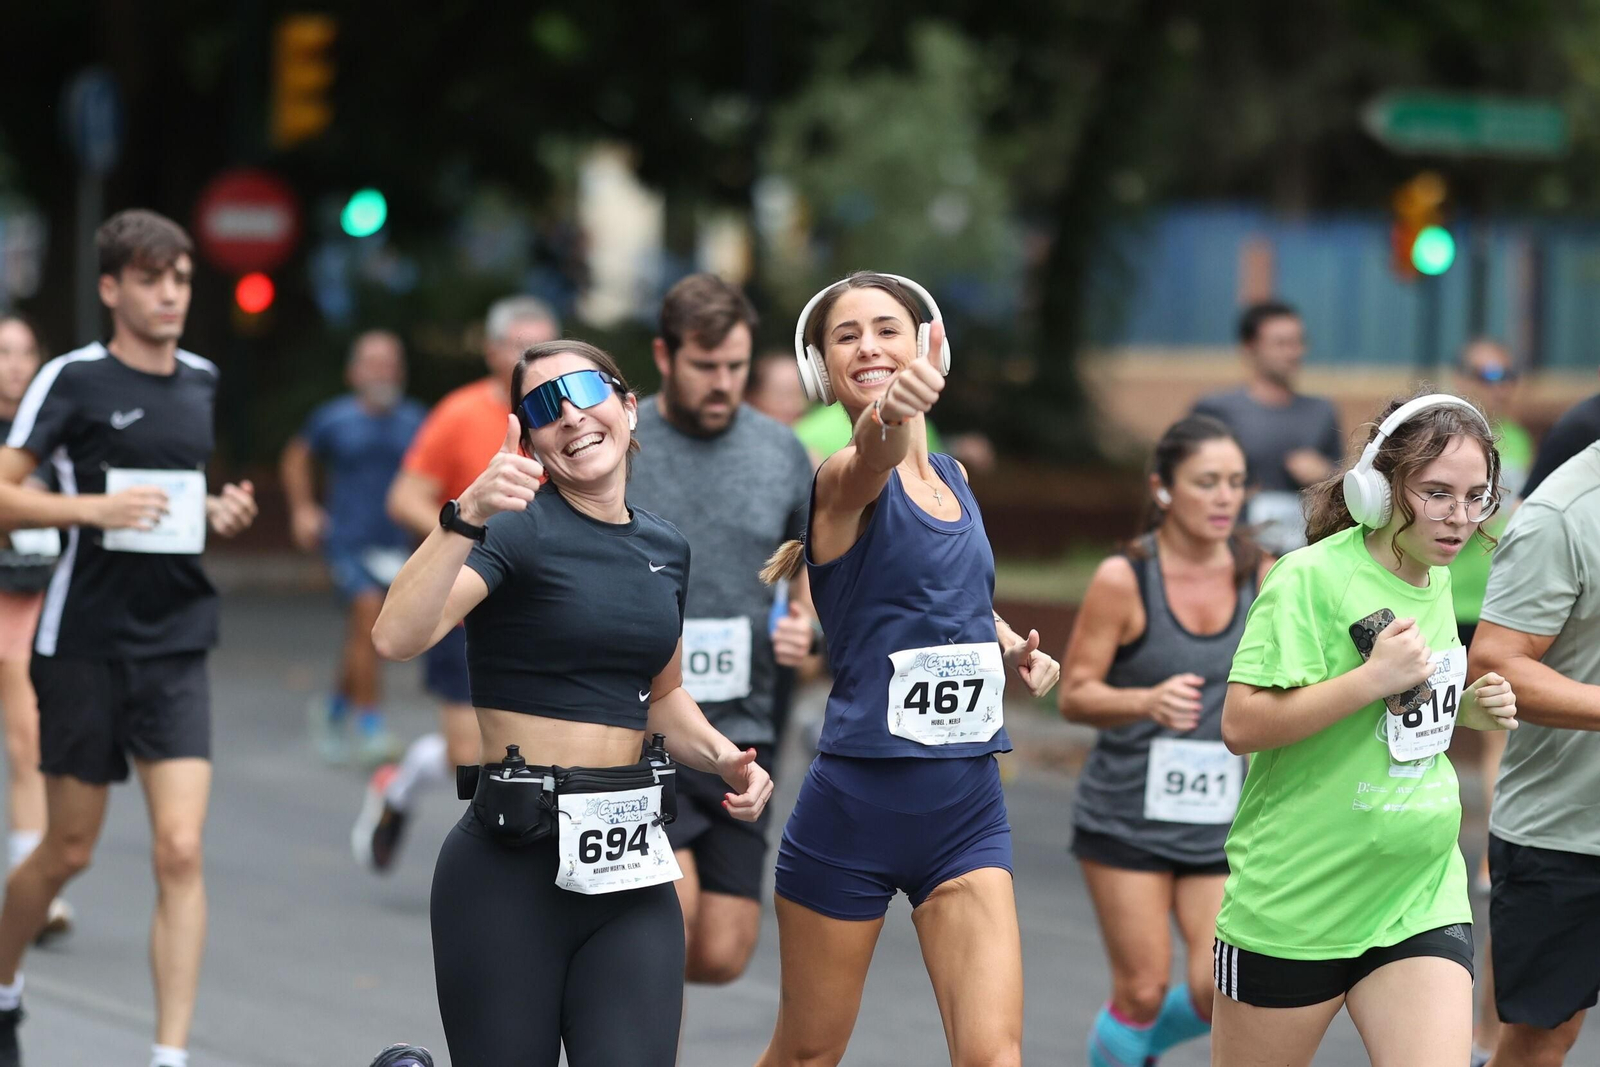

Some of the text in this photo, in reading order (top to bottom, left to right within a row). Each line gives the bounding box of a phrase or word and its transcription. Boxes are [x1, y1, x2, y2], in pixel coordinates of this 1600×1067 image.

[689, 650, 734, 675] 06
[926, 653, 972, 669] Carrera
[936, 664, 976, 677] Prensa
[904, 679, 984, 714] 467
[1165, 770, 1226, 797] 941
[599, 799, 641, 816] Carrera
[608, 811, 642, 824] Prensa
[579, 823, 650, 864] 694
